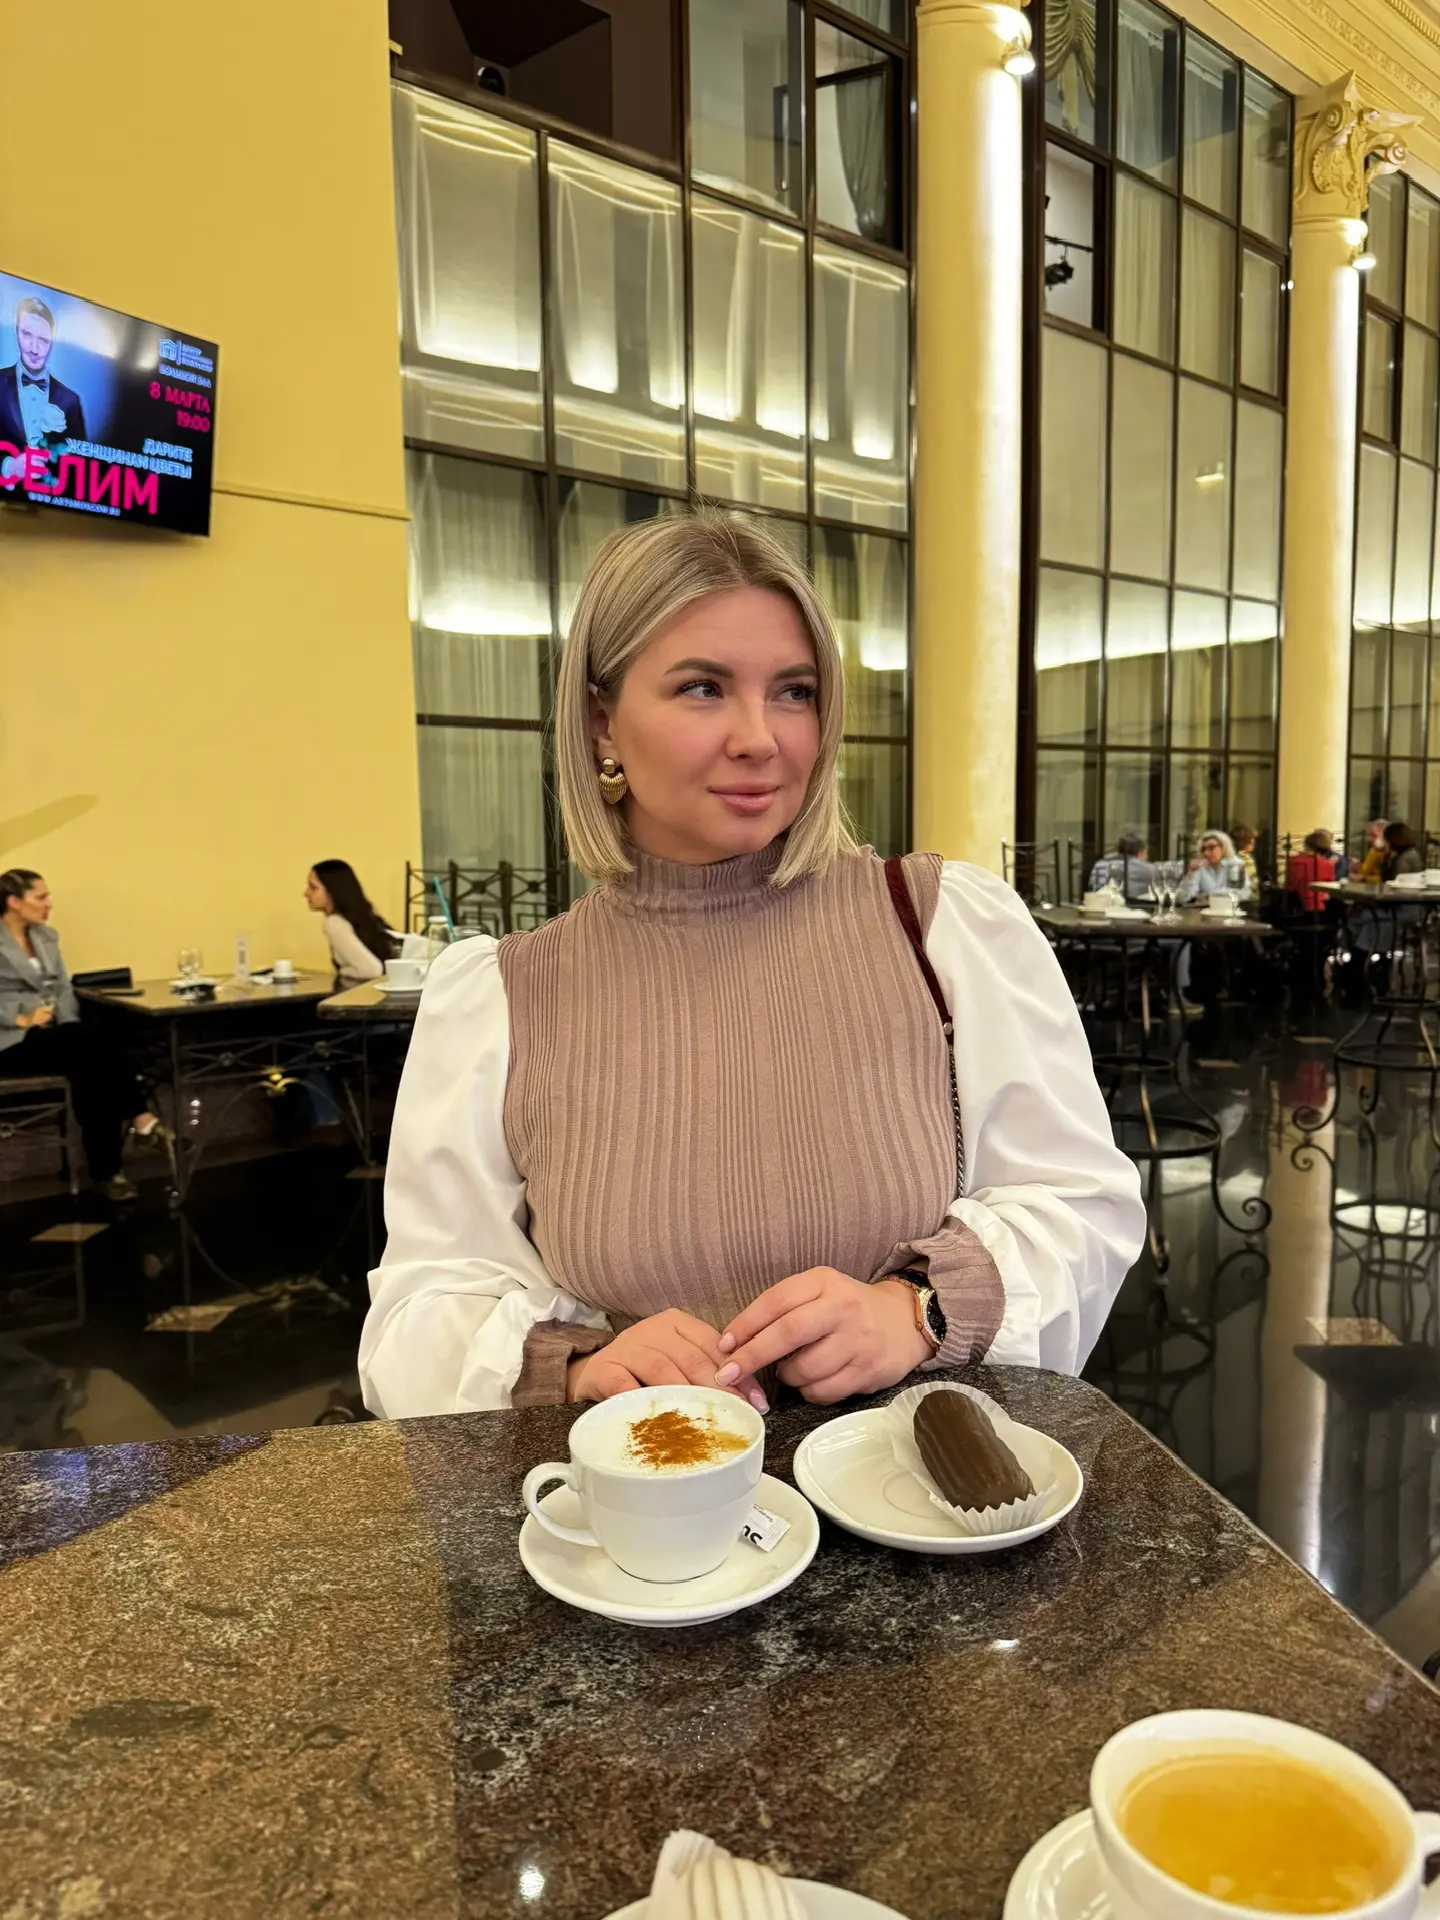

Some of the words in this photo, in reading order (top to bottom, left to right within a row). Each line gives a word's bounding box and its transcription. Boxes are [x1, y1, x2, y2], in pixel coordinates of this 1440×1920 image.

[150, 381, 160, 399] 8
[165, 386, 210, 414] МАРТА
[176, 410, 210, 433] 19:00
[65, 438, 148, 471] ЖЕНЩИНАМ
[149, 456, 192, 479] ЦВЕТЫ
[142, 438, 193, 462] ДАРИТЕ
[0, 440, 159, 515] СЕЛИМ
